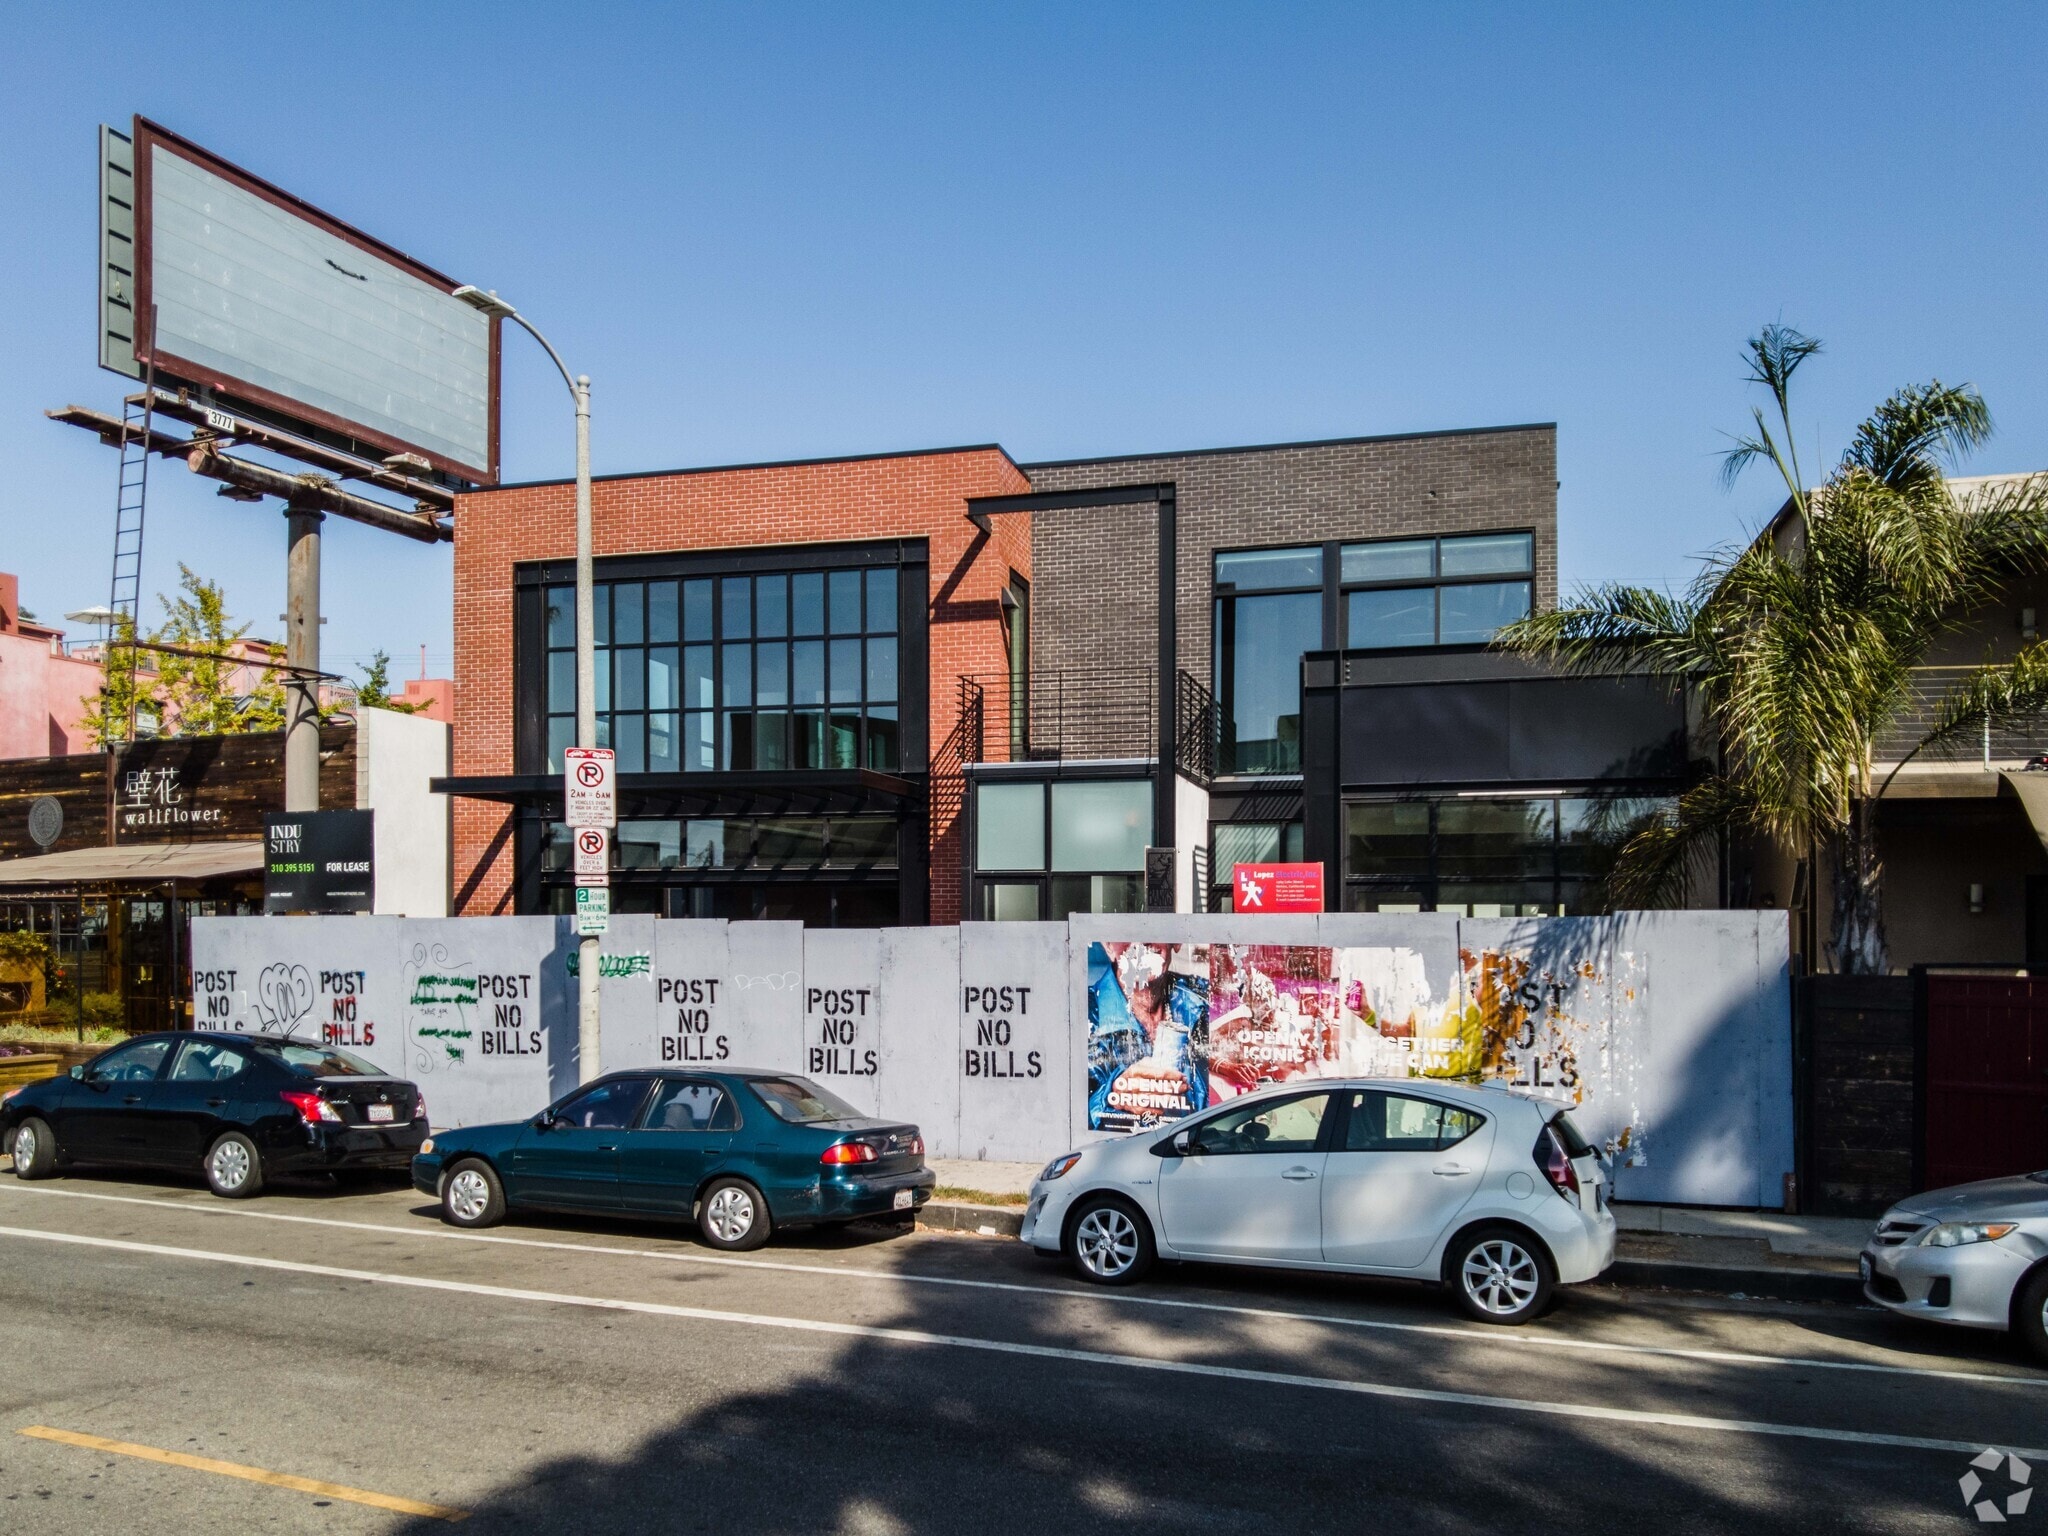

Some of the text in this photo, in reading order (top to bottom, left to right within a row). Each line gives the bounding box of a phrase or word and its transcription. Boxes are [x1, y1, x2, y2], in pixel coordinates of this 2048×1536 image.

[212, 411, 232, 428] 3777
[125, 767, 182, 807] 壁花
[571, 789, 586, 798] 2AM
[125, 808, 220, 824] wallflower
[270, 825, 302, 839] INDU
[270, 839, 302, 853] STRY
[271, 861, 370, 872] 310 395 5151 FOR LEASE
[1254, 871, 1275, 880] Lopez
[579, 890, 606, 901] 2 HOUR
[579, 904, 607, 912] PARKING
[194, 970, 237, 993] POST
[321, 971, 365, 994] POST
[478, 974, 531, 998] POST
[658, 979, 719, 1004] POST
[208, 996, 230, 1017] NO
[333, 998, 357, 1022] NO
[808, 989, 871, 1016] POST
[964, 986, 1031, 1015] POST
[495, 1004, 522, 1028] NO
[678, 1009, 709, 1034] NO
[322, 1023, 374, 1046] BILLS
[482, 1031, 542, 1054] BILLS
[822, 1018, 855, 1045] NO
[977, 1019, 1011, 1046] NO
[661, 1036, 729, 1061] BILLS
[1243, 1045, 1305, 1063] ICONIC
[1364, 1036, 1464, 1052] GETHER
[809, 1048, 877, 1075] BILLS
[964, 1050, 1042, 1078] BILLS
[1407, 1053, 1449, 1071] CAN
[1114, 1077, 1183, 1093] OPENLY
[1107, 1092, 1190, 1110] ORIGINAL
